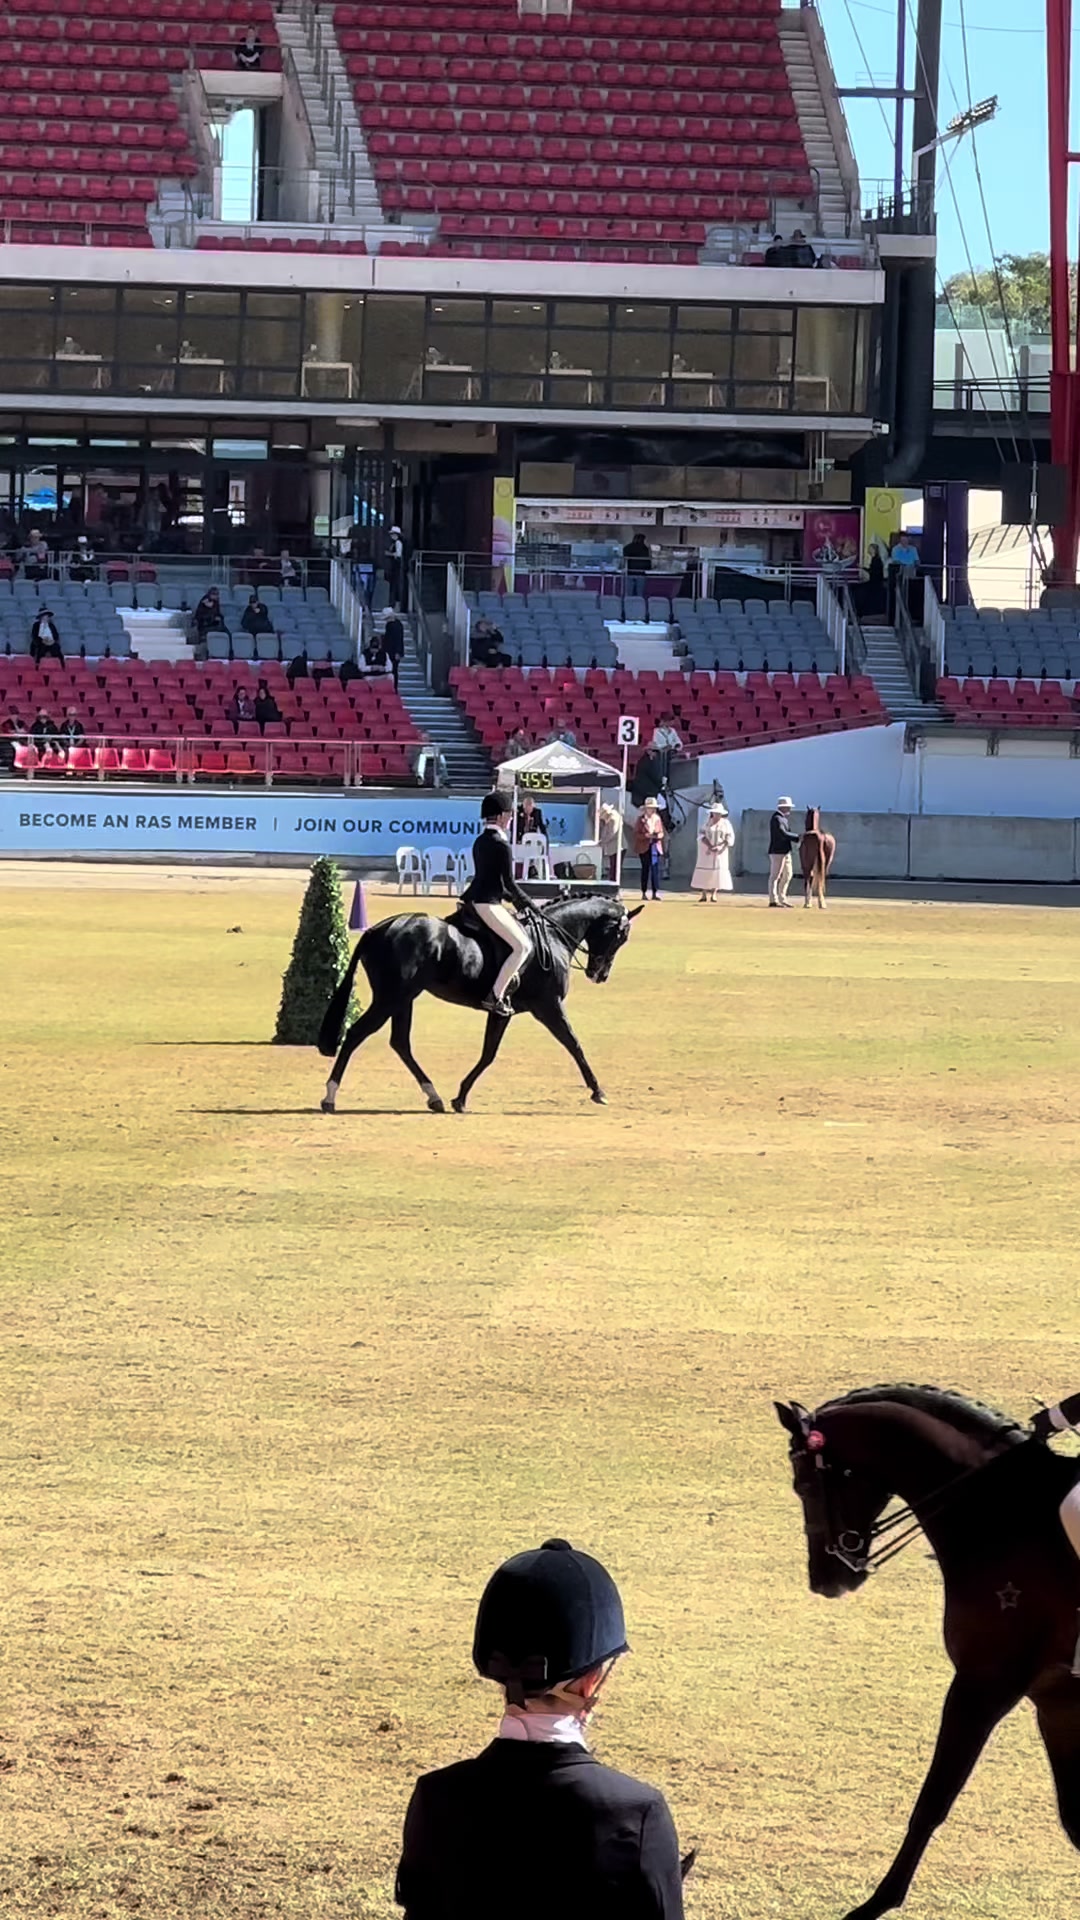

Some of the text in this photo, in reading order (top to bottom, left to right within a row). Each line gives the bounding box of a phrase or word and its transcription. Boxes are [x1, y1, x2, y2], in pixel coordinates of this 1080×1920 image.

[622, 719, 635, 742] 3
[19, 813, 484, 835] BECOME AN RAS MEMBER JOIN OUR COMMUNI
